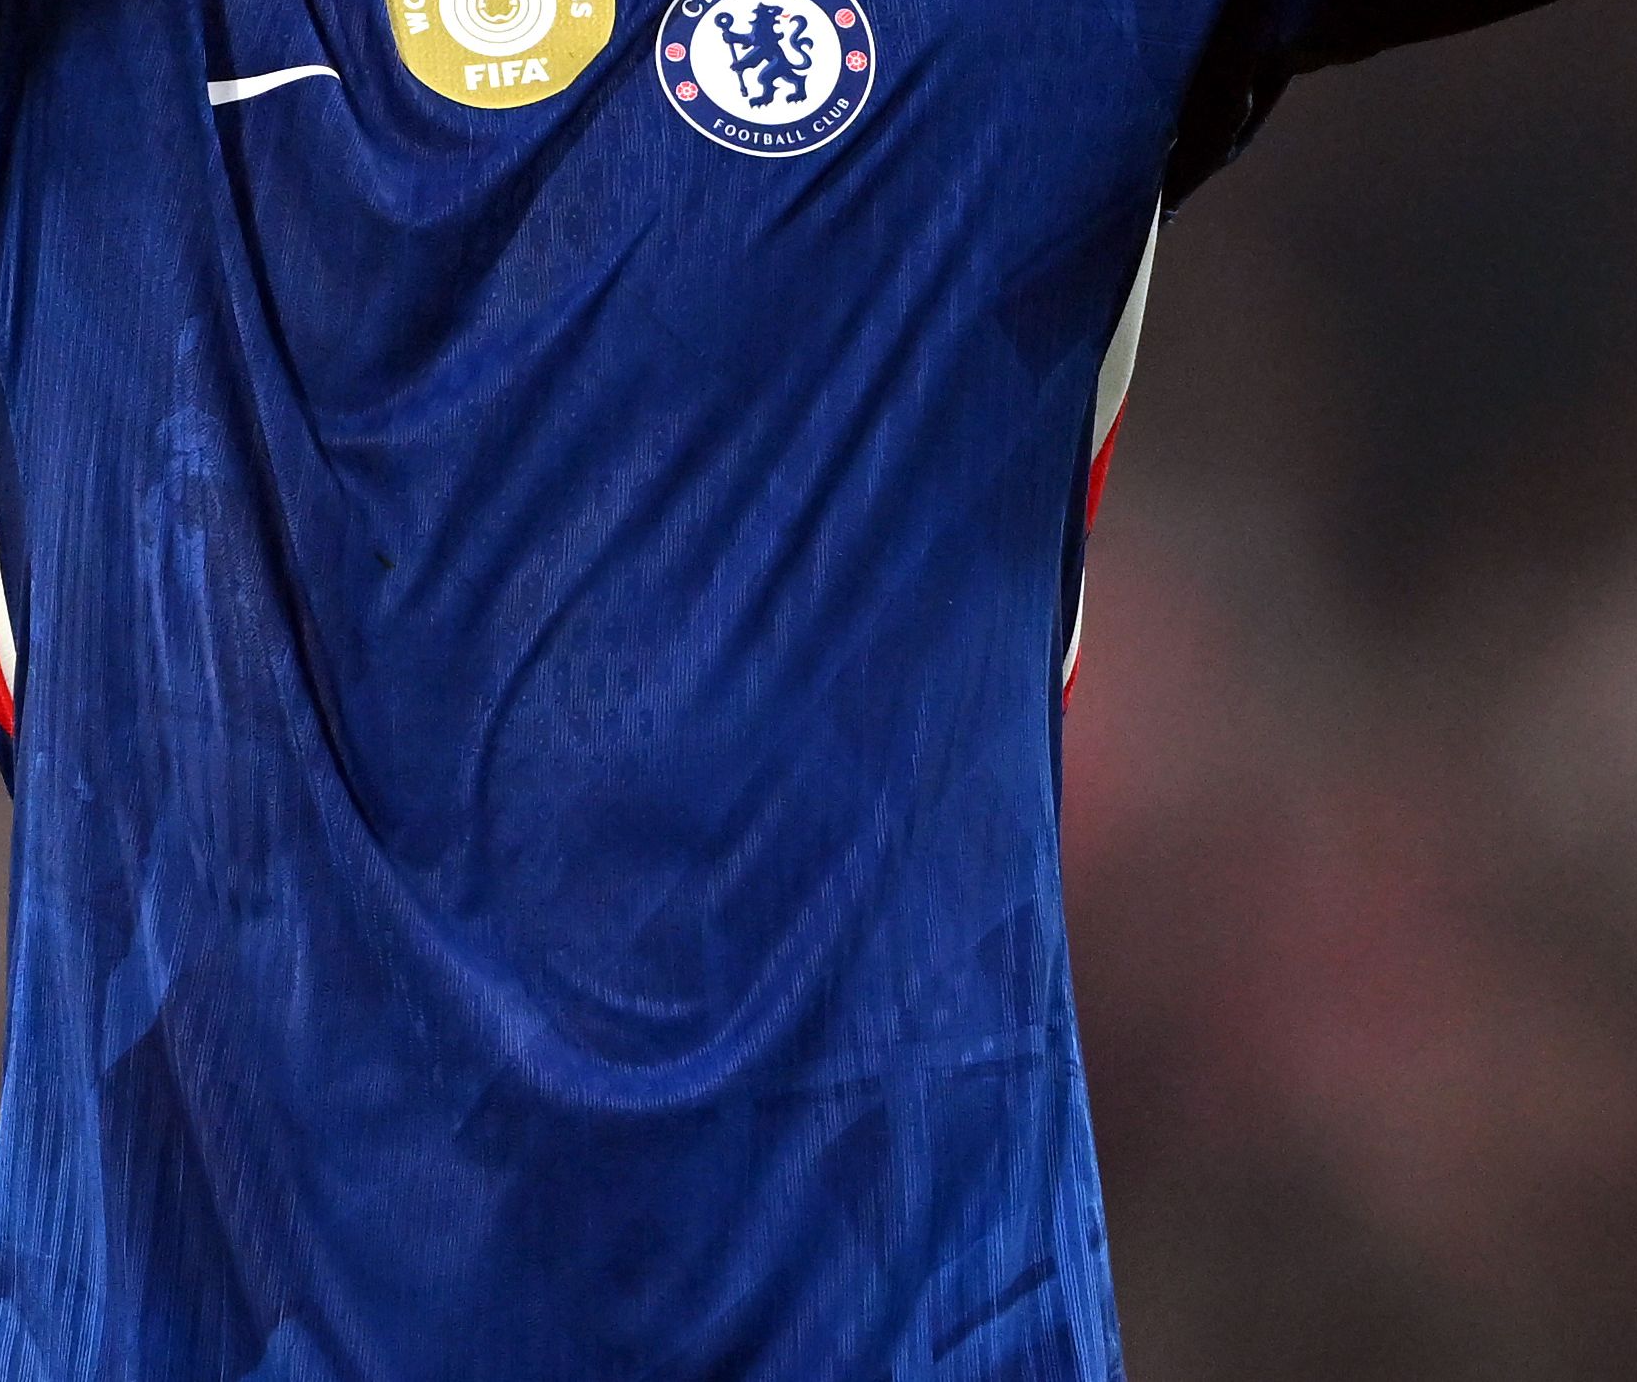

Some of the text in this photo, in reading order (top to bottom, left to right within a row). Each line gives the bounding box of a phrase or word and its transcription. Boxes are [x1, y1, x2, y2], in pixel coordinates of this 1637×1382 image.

[463, 57, 550, 90] FIFA
[713, 97, 851, 146] FOOTBALL CLUB
